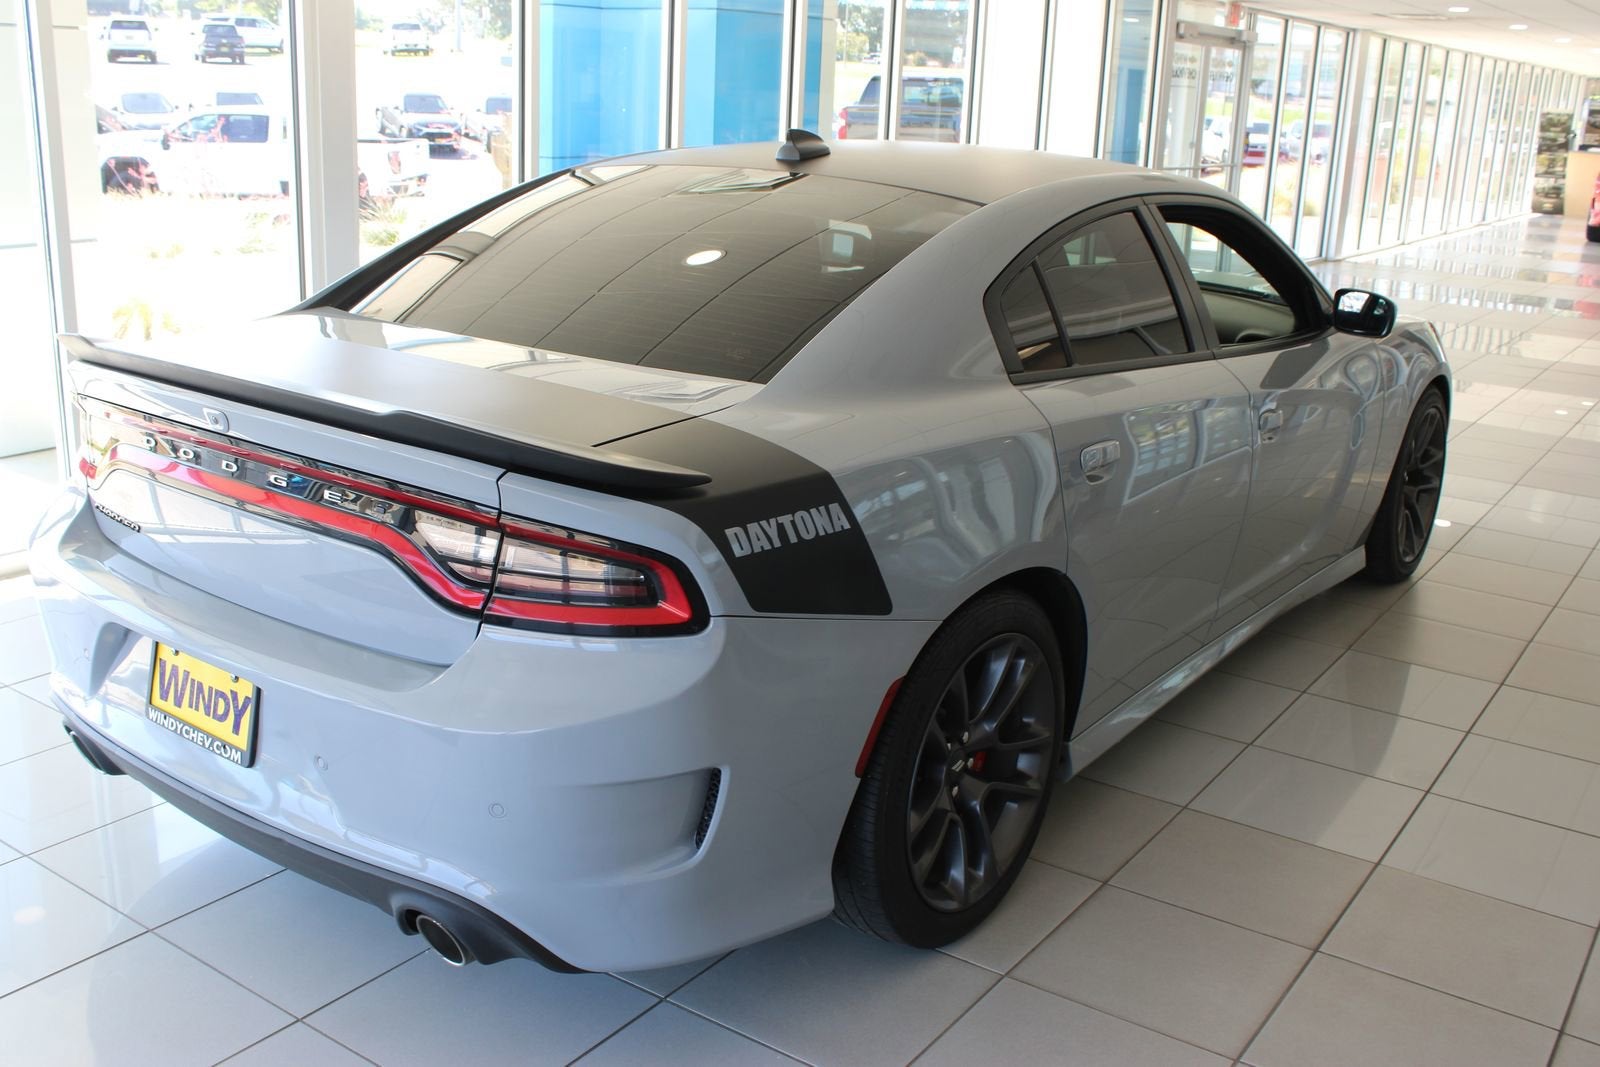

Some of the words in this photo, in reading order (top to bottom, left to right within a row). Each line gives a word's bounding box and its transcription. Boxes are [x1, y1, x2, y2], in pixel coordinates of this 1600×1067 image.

[142, 436, 343, 504] DODGE
[724, 502, 851, 558] DAYTONA
[158, 657, 253, 736] WINDY
[148, 707, 242, 765] WINDYCHEV.COM
